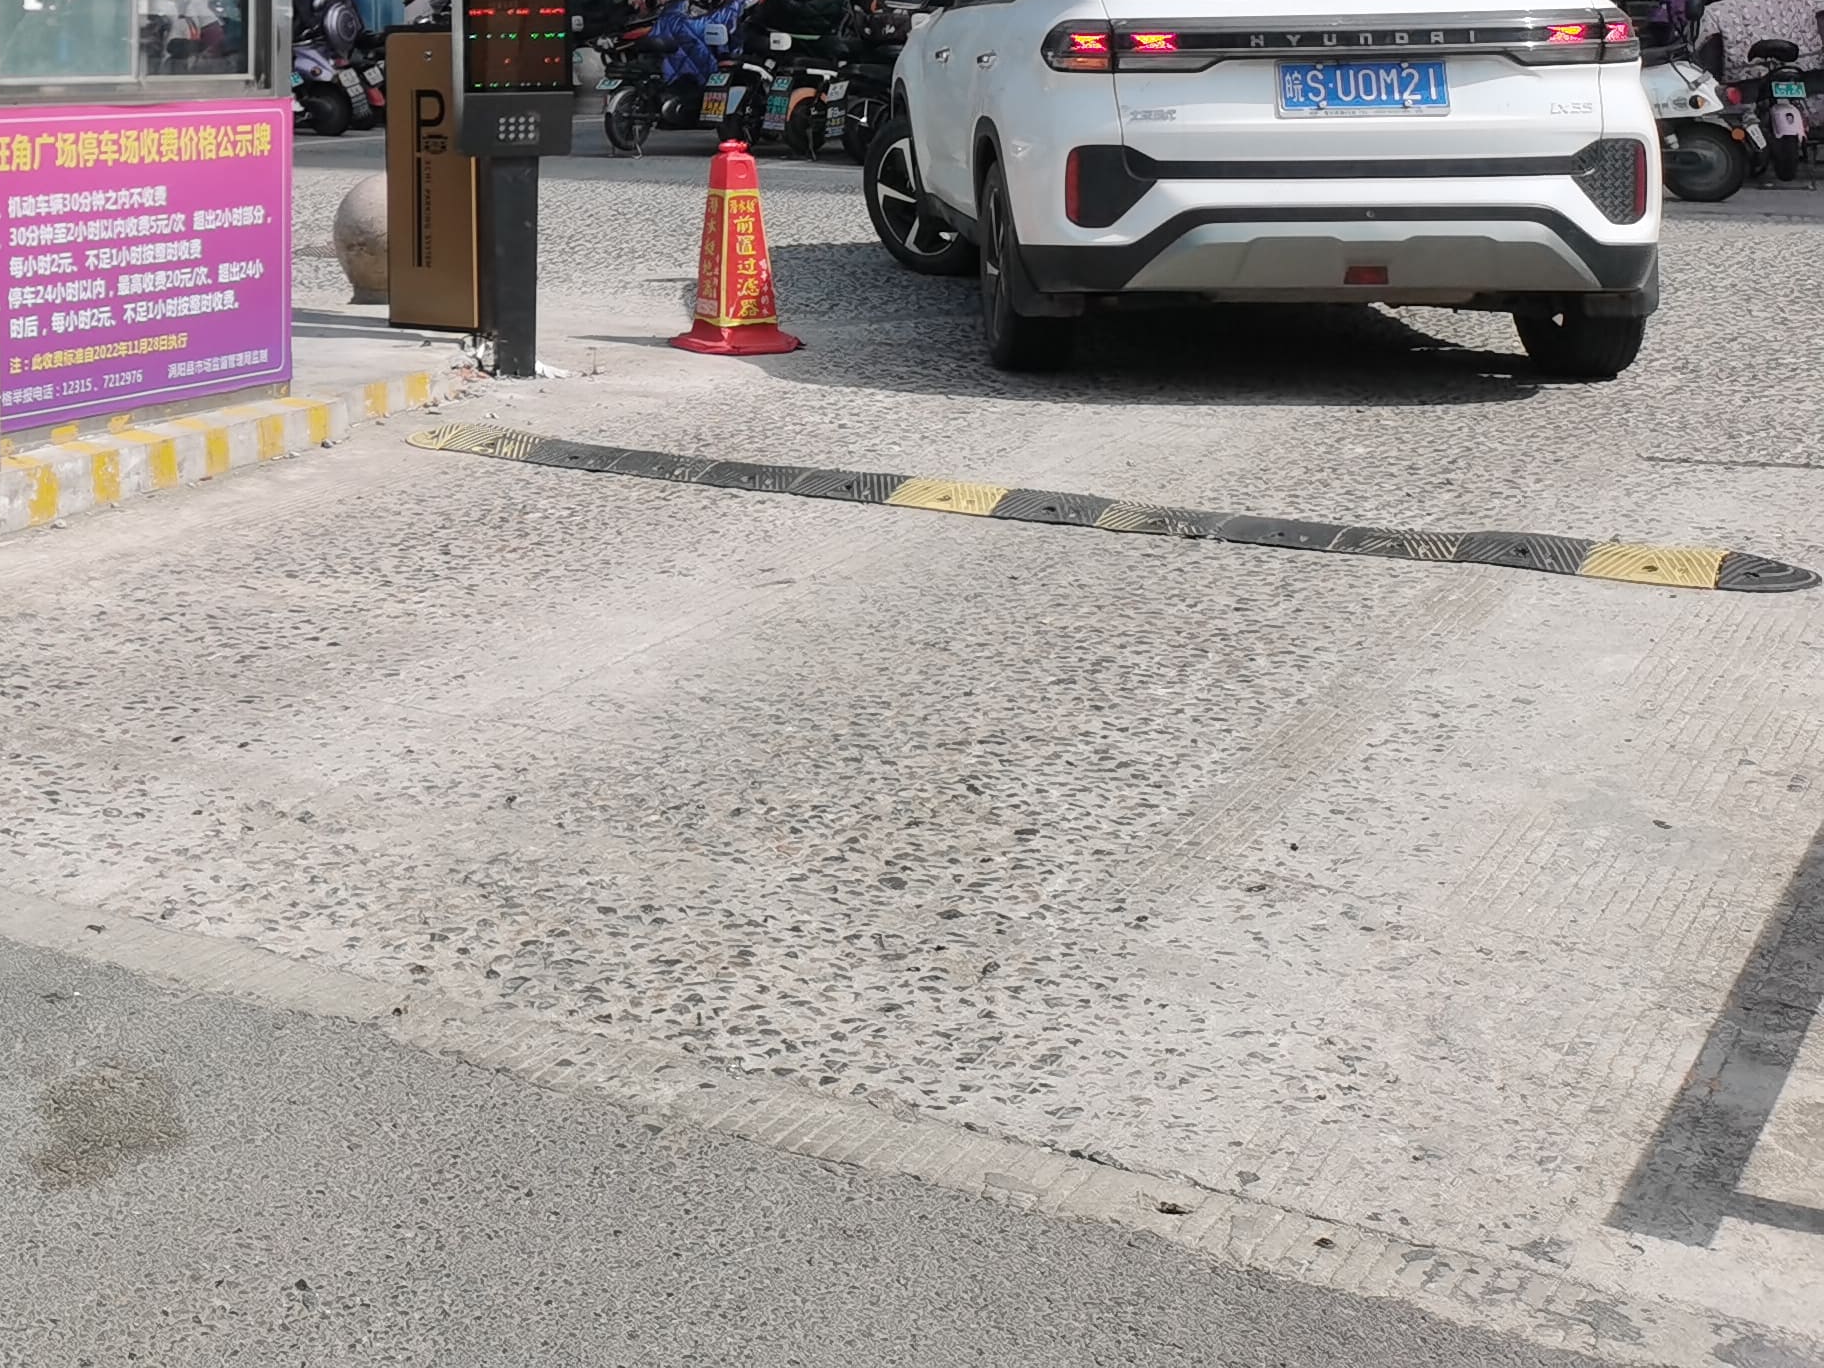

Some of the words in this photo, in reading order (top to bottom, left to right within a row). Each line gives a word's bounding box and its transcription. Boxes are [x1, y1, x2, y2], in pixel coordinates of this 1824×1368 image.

[1250, 29, 1476, 48] HYUNDAI
[733, 215, 761, 317] 前置过滤器
